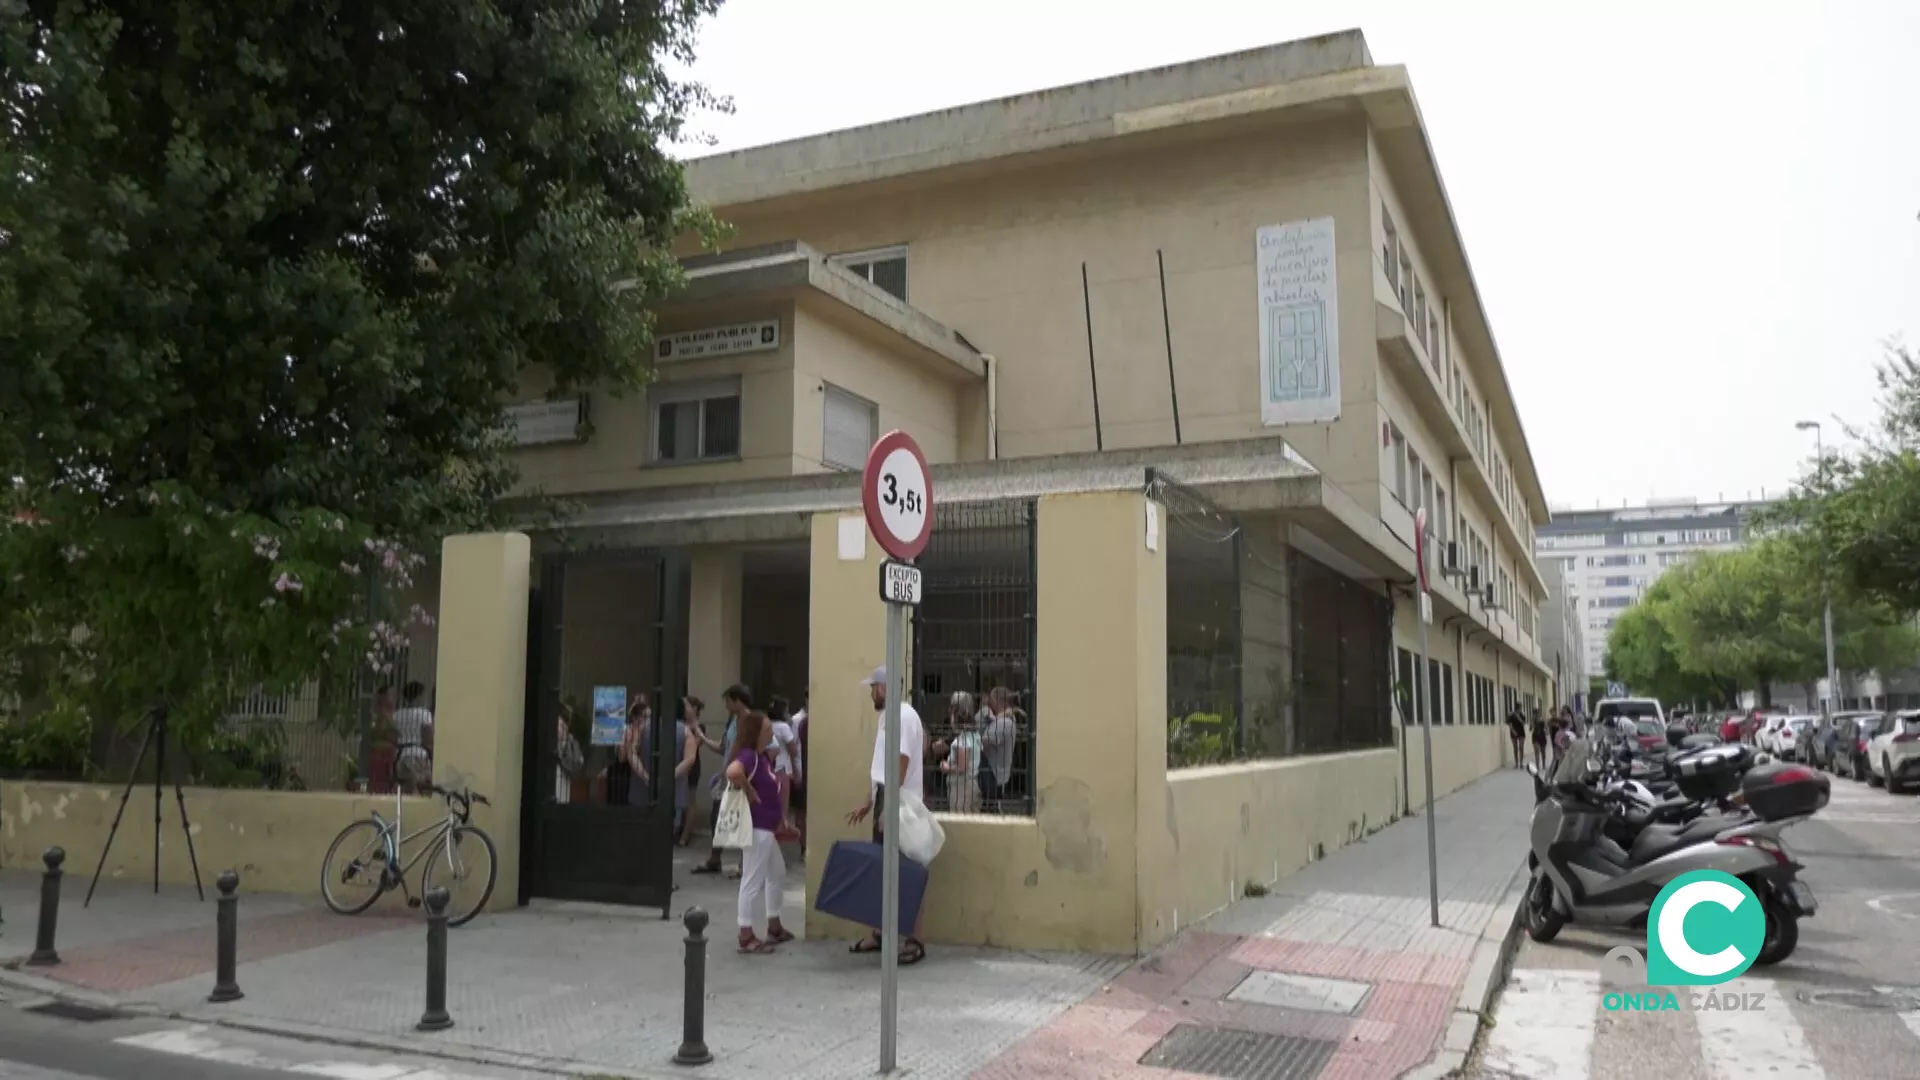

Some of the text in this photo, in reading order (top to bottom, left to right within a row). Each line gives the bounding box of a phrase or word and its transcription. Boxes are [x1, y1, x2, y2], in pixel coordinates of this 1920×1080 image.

[675, 331, 714, 345] COLEGIO
[883, 472, 922, 515] 3,5t
[888, 565, 918, 584] EXCEPTO
[893, 581, 913, 601] BUS
